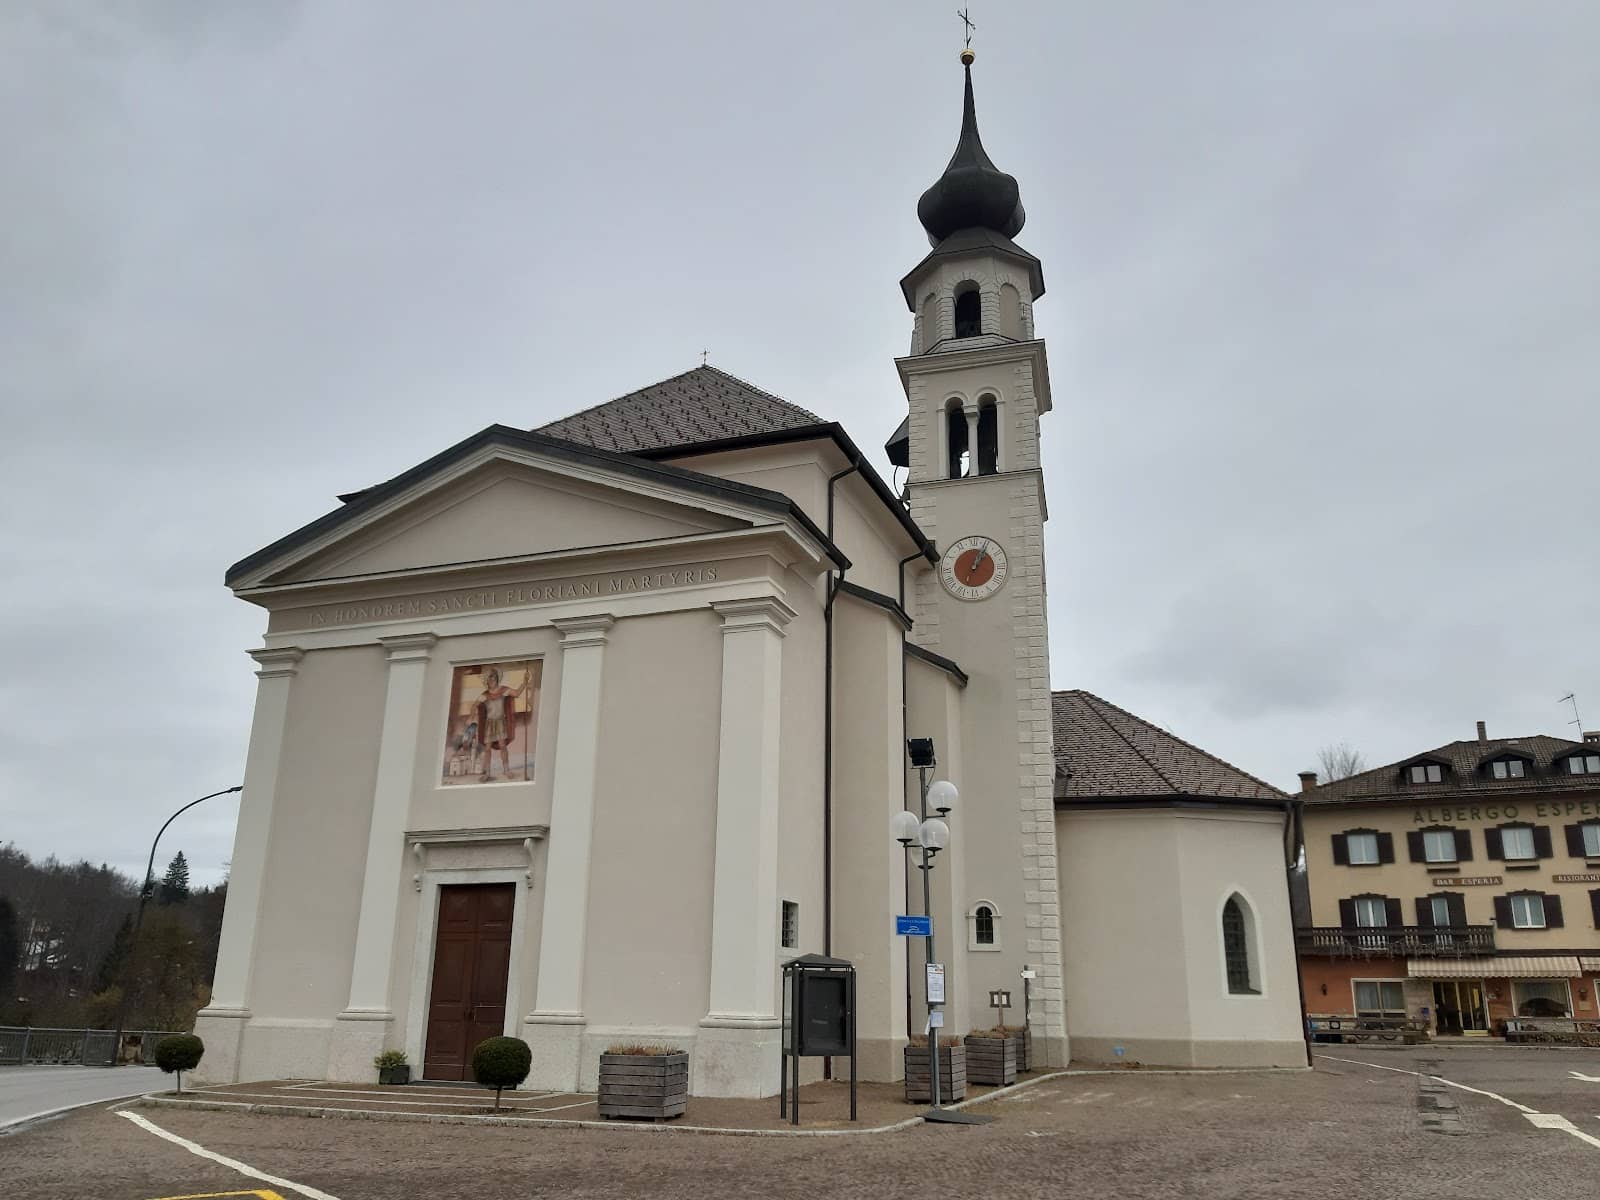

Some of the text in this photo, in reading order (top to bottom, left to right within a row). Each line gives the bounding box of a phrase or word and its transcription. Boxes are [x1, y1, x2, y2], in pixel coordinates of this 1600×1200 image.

[308, 567, 718, 625] IN HONOREM SANCTI FLORIANI MARTYRIS
[1413, 805, 1519, 824] ALBERGO
[1436, 877, 1500, 886] BAR ESPERIA
